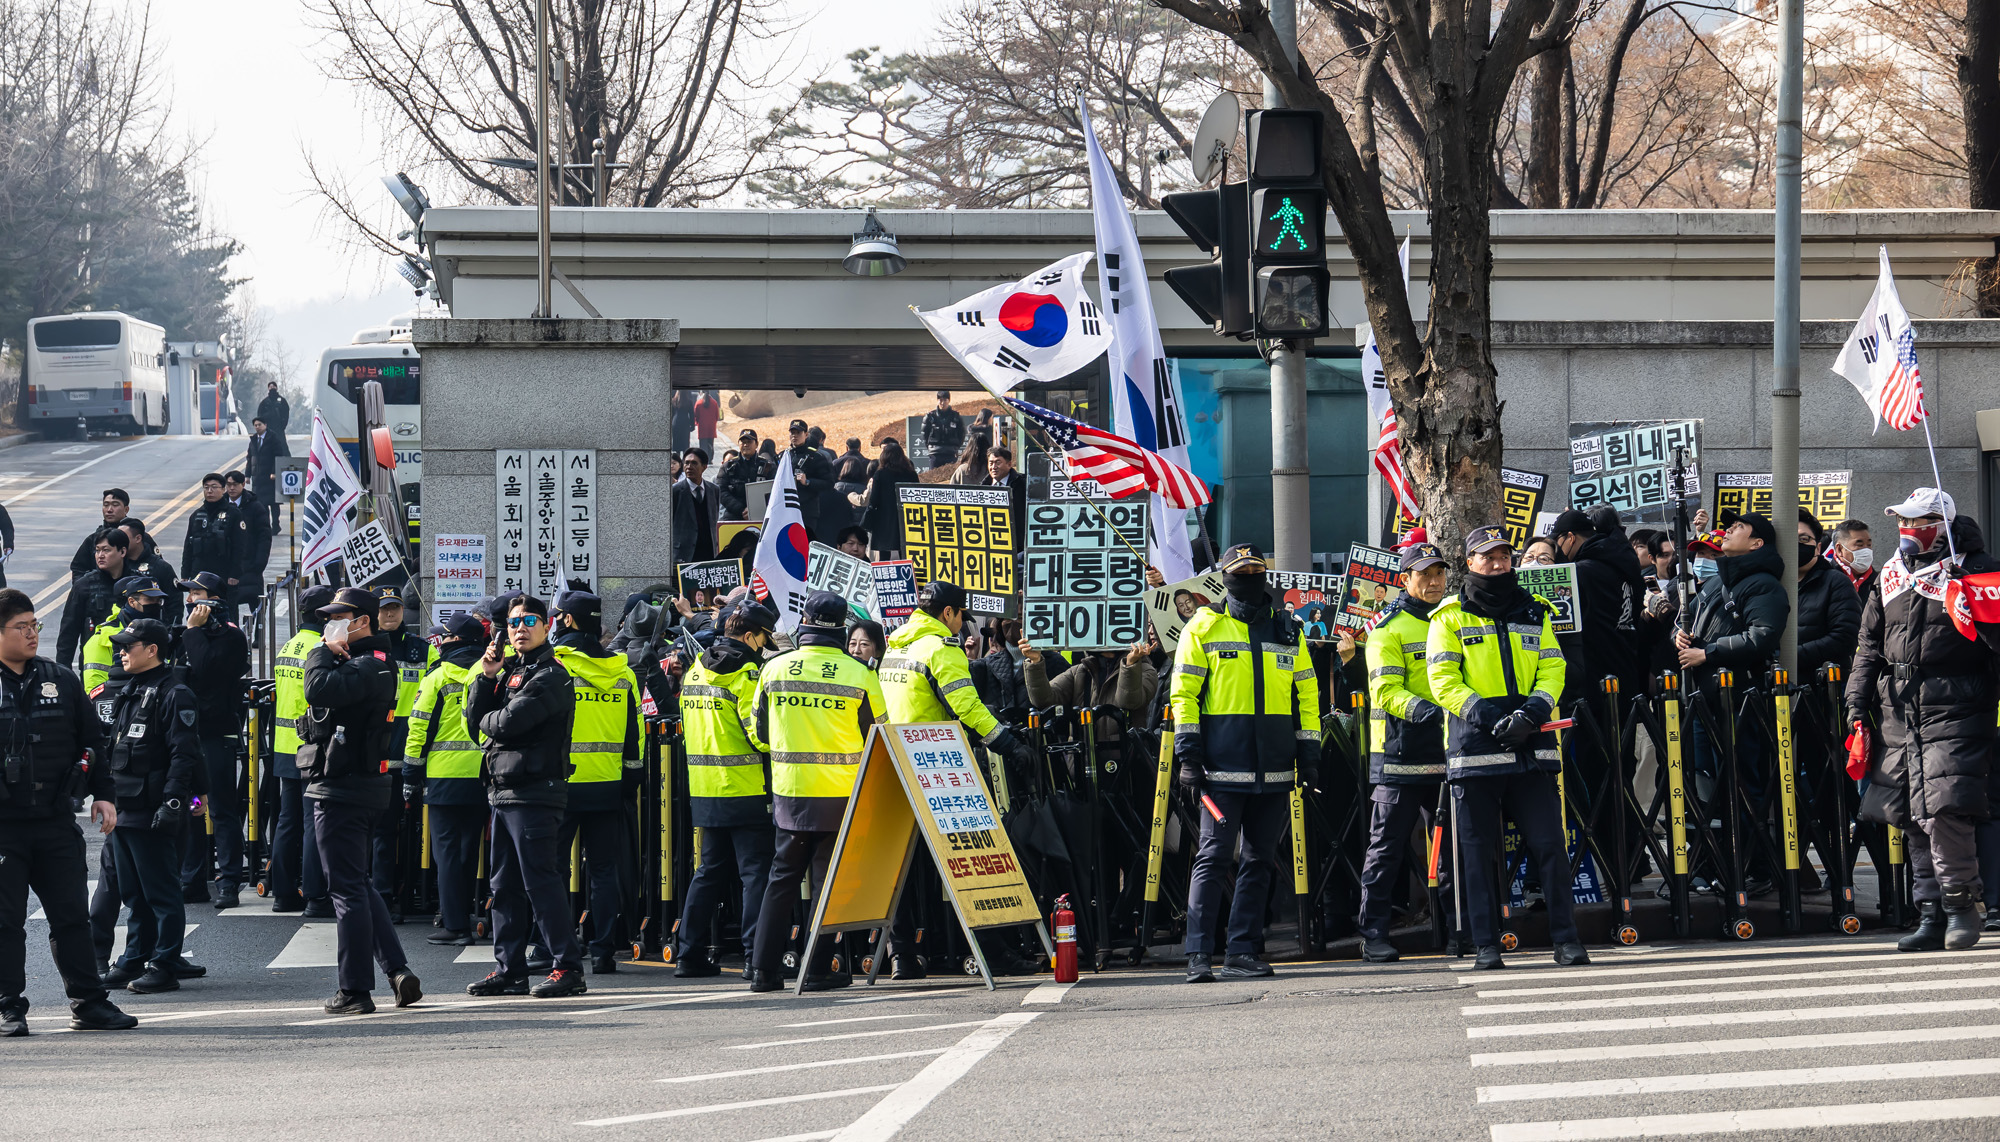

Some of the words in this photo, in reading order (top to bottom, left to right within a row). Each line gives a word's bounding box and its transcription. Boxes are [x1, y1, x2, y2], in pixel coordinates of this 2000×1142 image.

[355, 366, 377, 378] 양보
[383, 365, 405, 378] 배려
[1573, 440, 1600, 453] 언제나
[1606, 424, 1694, 470] 힘내라
[1575, 457, 1601, 471] 파이팅
[1502, 471, 1541, 487] 용=공수처
[1052, 482, 1108, 498] 응원합니
[1574, 470, 1664, 510] 윤석열
[570, 454, 590, 591] 서울고등법
[906, 507, 1009, 546] 딱풀공문
[1029, 504, 1144, 547] 윤석열
[343, 526, 383, 560] 내란은
[437, 538, 484, 546] 중요재판으로
[350, 545, 394, 585] 없었다
[438, 552, 483, 562] 외부차량
[1352, 548, 1401, 572] 대통령님
[437, 568, 482, 579] 입차금지
[874, 567, 897, 579] 대통령
[909, 549, 1011, 592] 절차위반
[1029, 553, 1143, 596] 대통령
[1518, 567, 1567, 583] 대통령님
[698, 573, 740, 589] 감사합니다
[876, 580, 907, 593] 변호인단
[1917, 579, 1942, 596] YOON
[879, 593, 919, 607] 감사합니다
[974, 596, 1004, 612] 정당방위
[1299, 592, 1341, 606] 힘내세요
[1028, 602, 1143, 645] 화이팅
[789, 660, 838, 679] 경찰
[879, 673, 907, 683] OLICE
[575, 692, 621, 702] OLICE
[684, 700, 723, 710] POLICE
[776, 696, 845, 710] POLICE
[903, 729, 956, 743] 중요재판으로
[991, 763, 1005, 815] POLIC
[1669, 731, 1687, 856] 질서유지선
[1782, 727, 1792, 793] POLICE
[1787, 807, 1796, 850] LINE
[929, 794, 988, 811] 외부주차장
[1147, 762, 1169, 884] 질서유지선
[947, 829, 996, 851] 오토바이
[947, 858, 973, 878] 인도
[969, 852, 1017, 876] 진입금지
